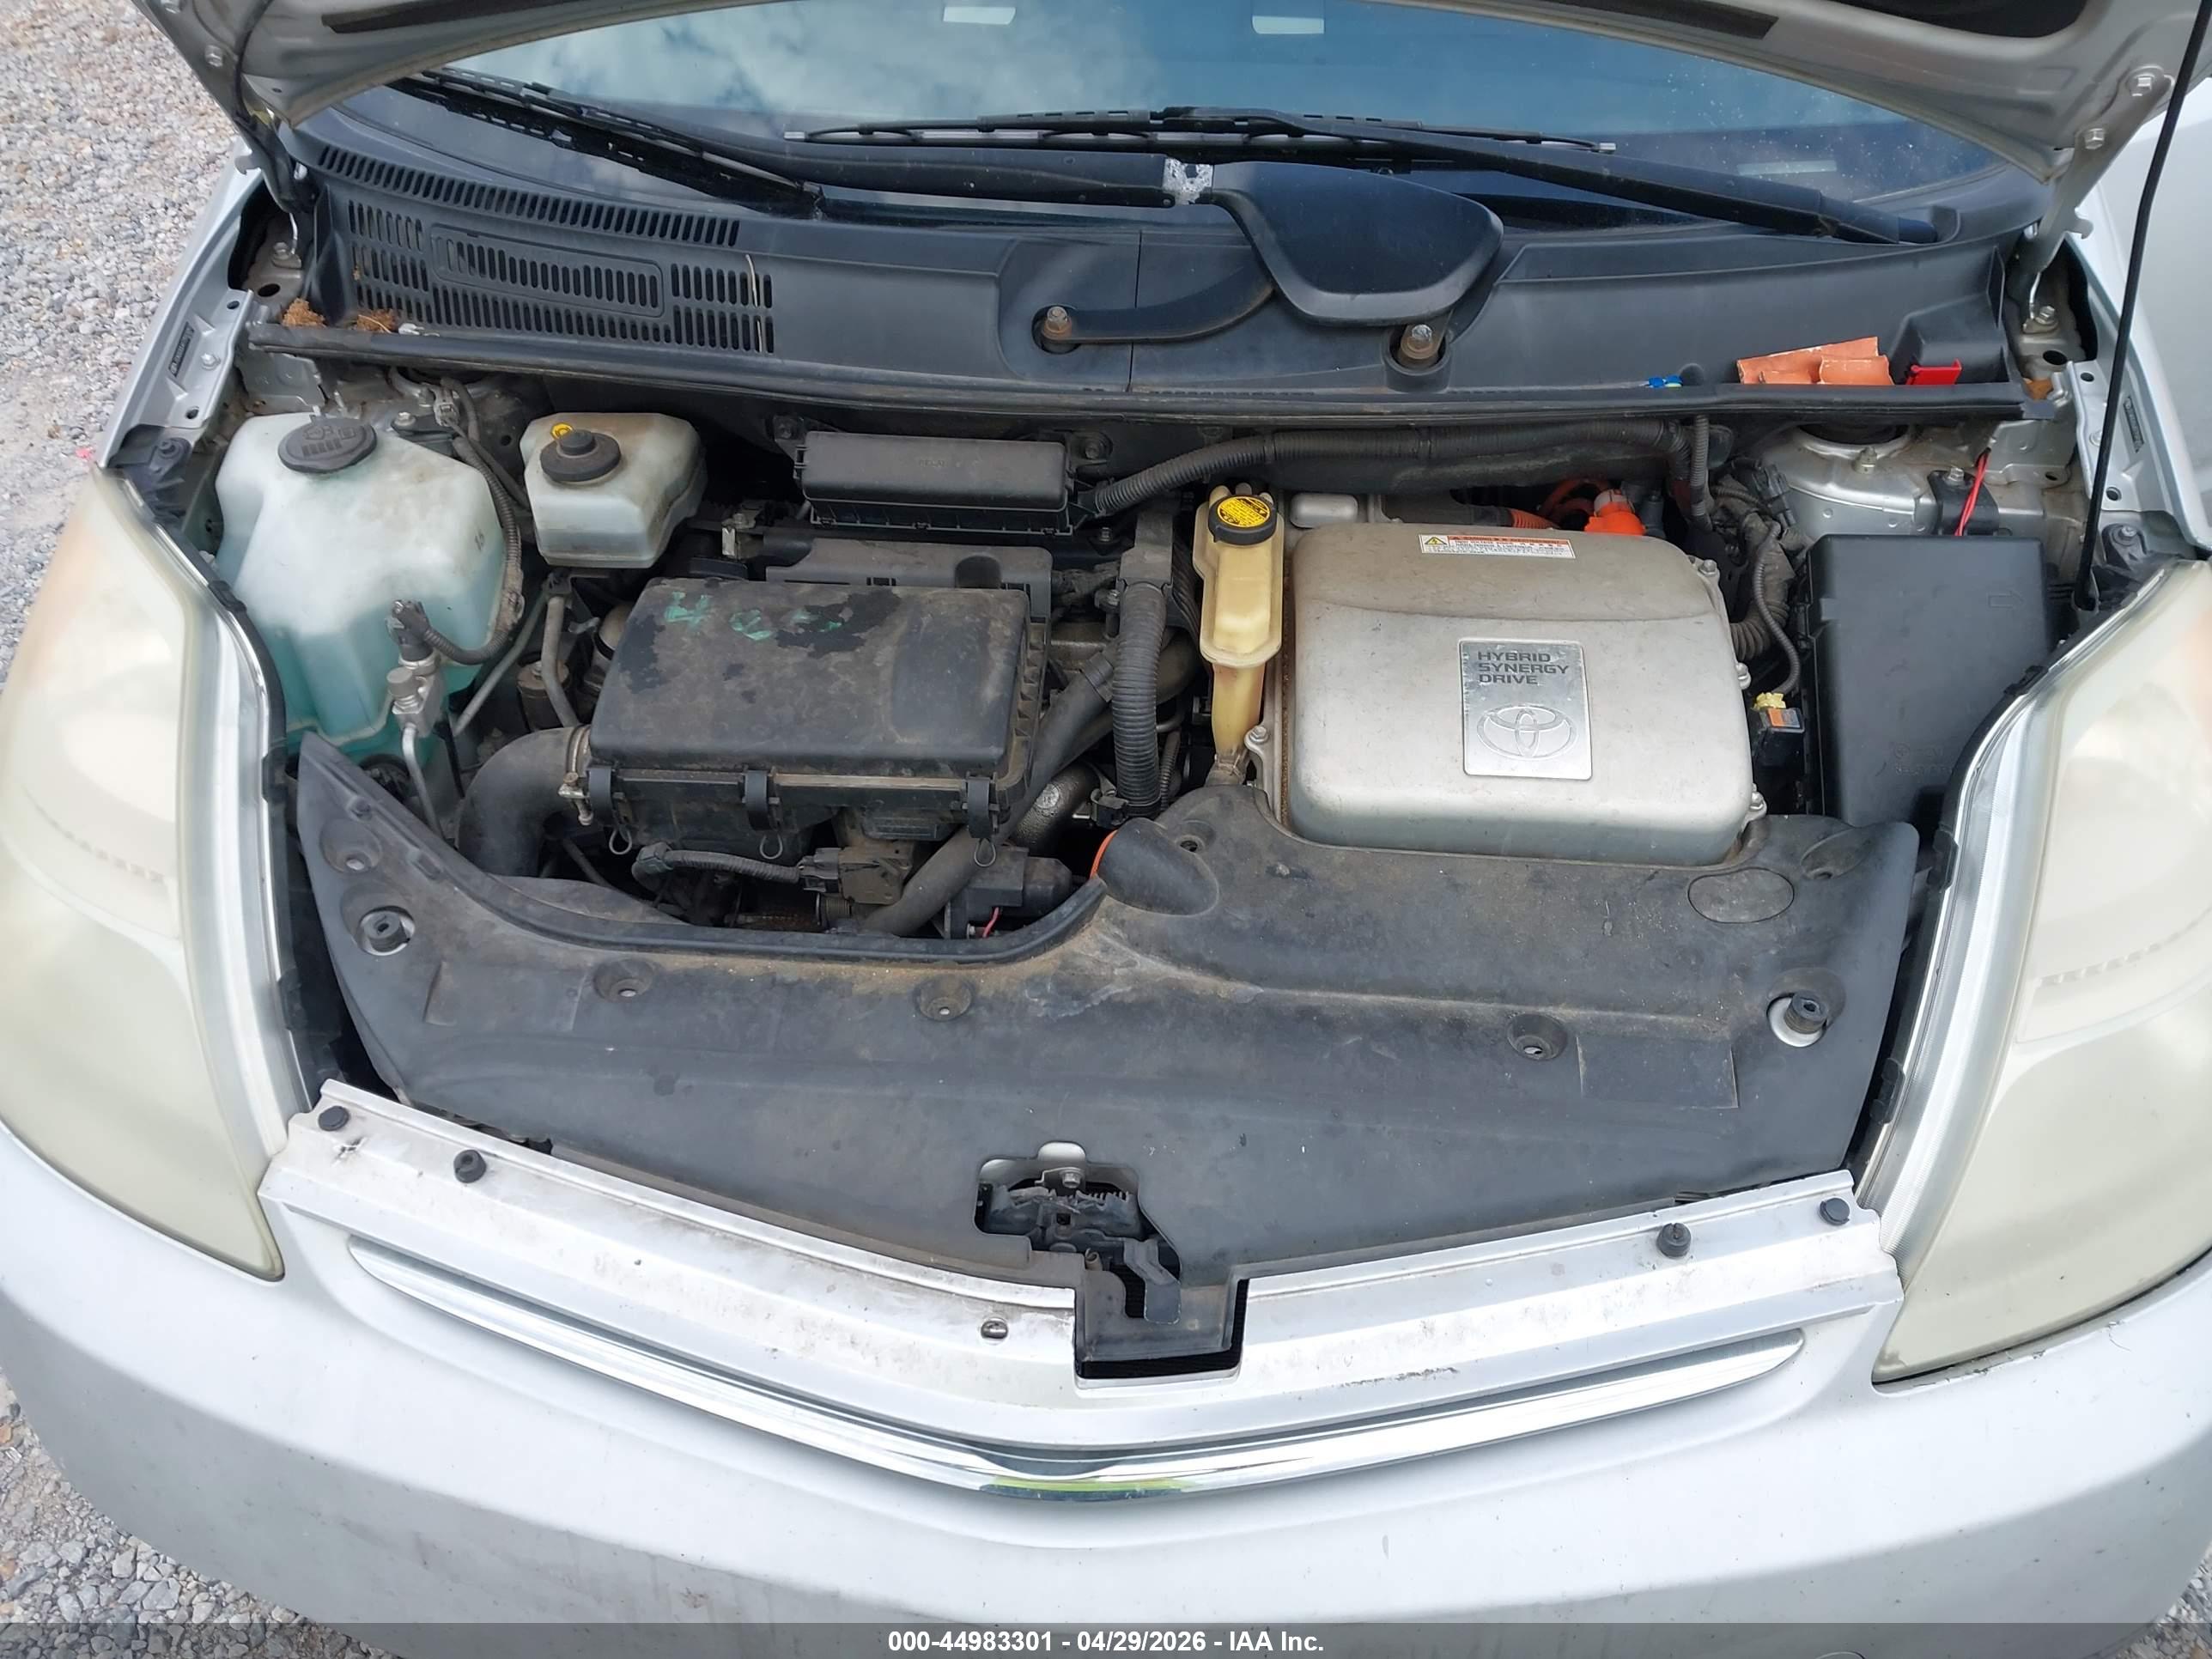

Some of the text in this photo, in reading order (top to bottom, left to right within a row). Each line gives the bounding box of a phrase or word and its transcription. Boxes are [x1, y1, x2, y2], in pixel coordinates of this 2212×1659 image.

[1477, 651, 1551, 662] HYBRID
[1478, 662, 1569, 674] SYNERGY
[1479, 673, 1538, 684] DRIVE
